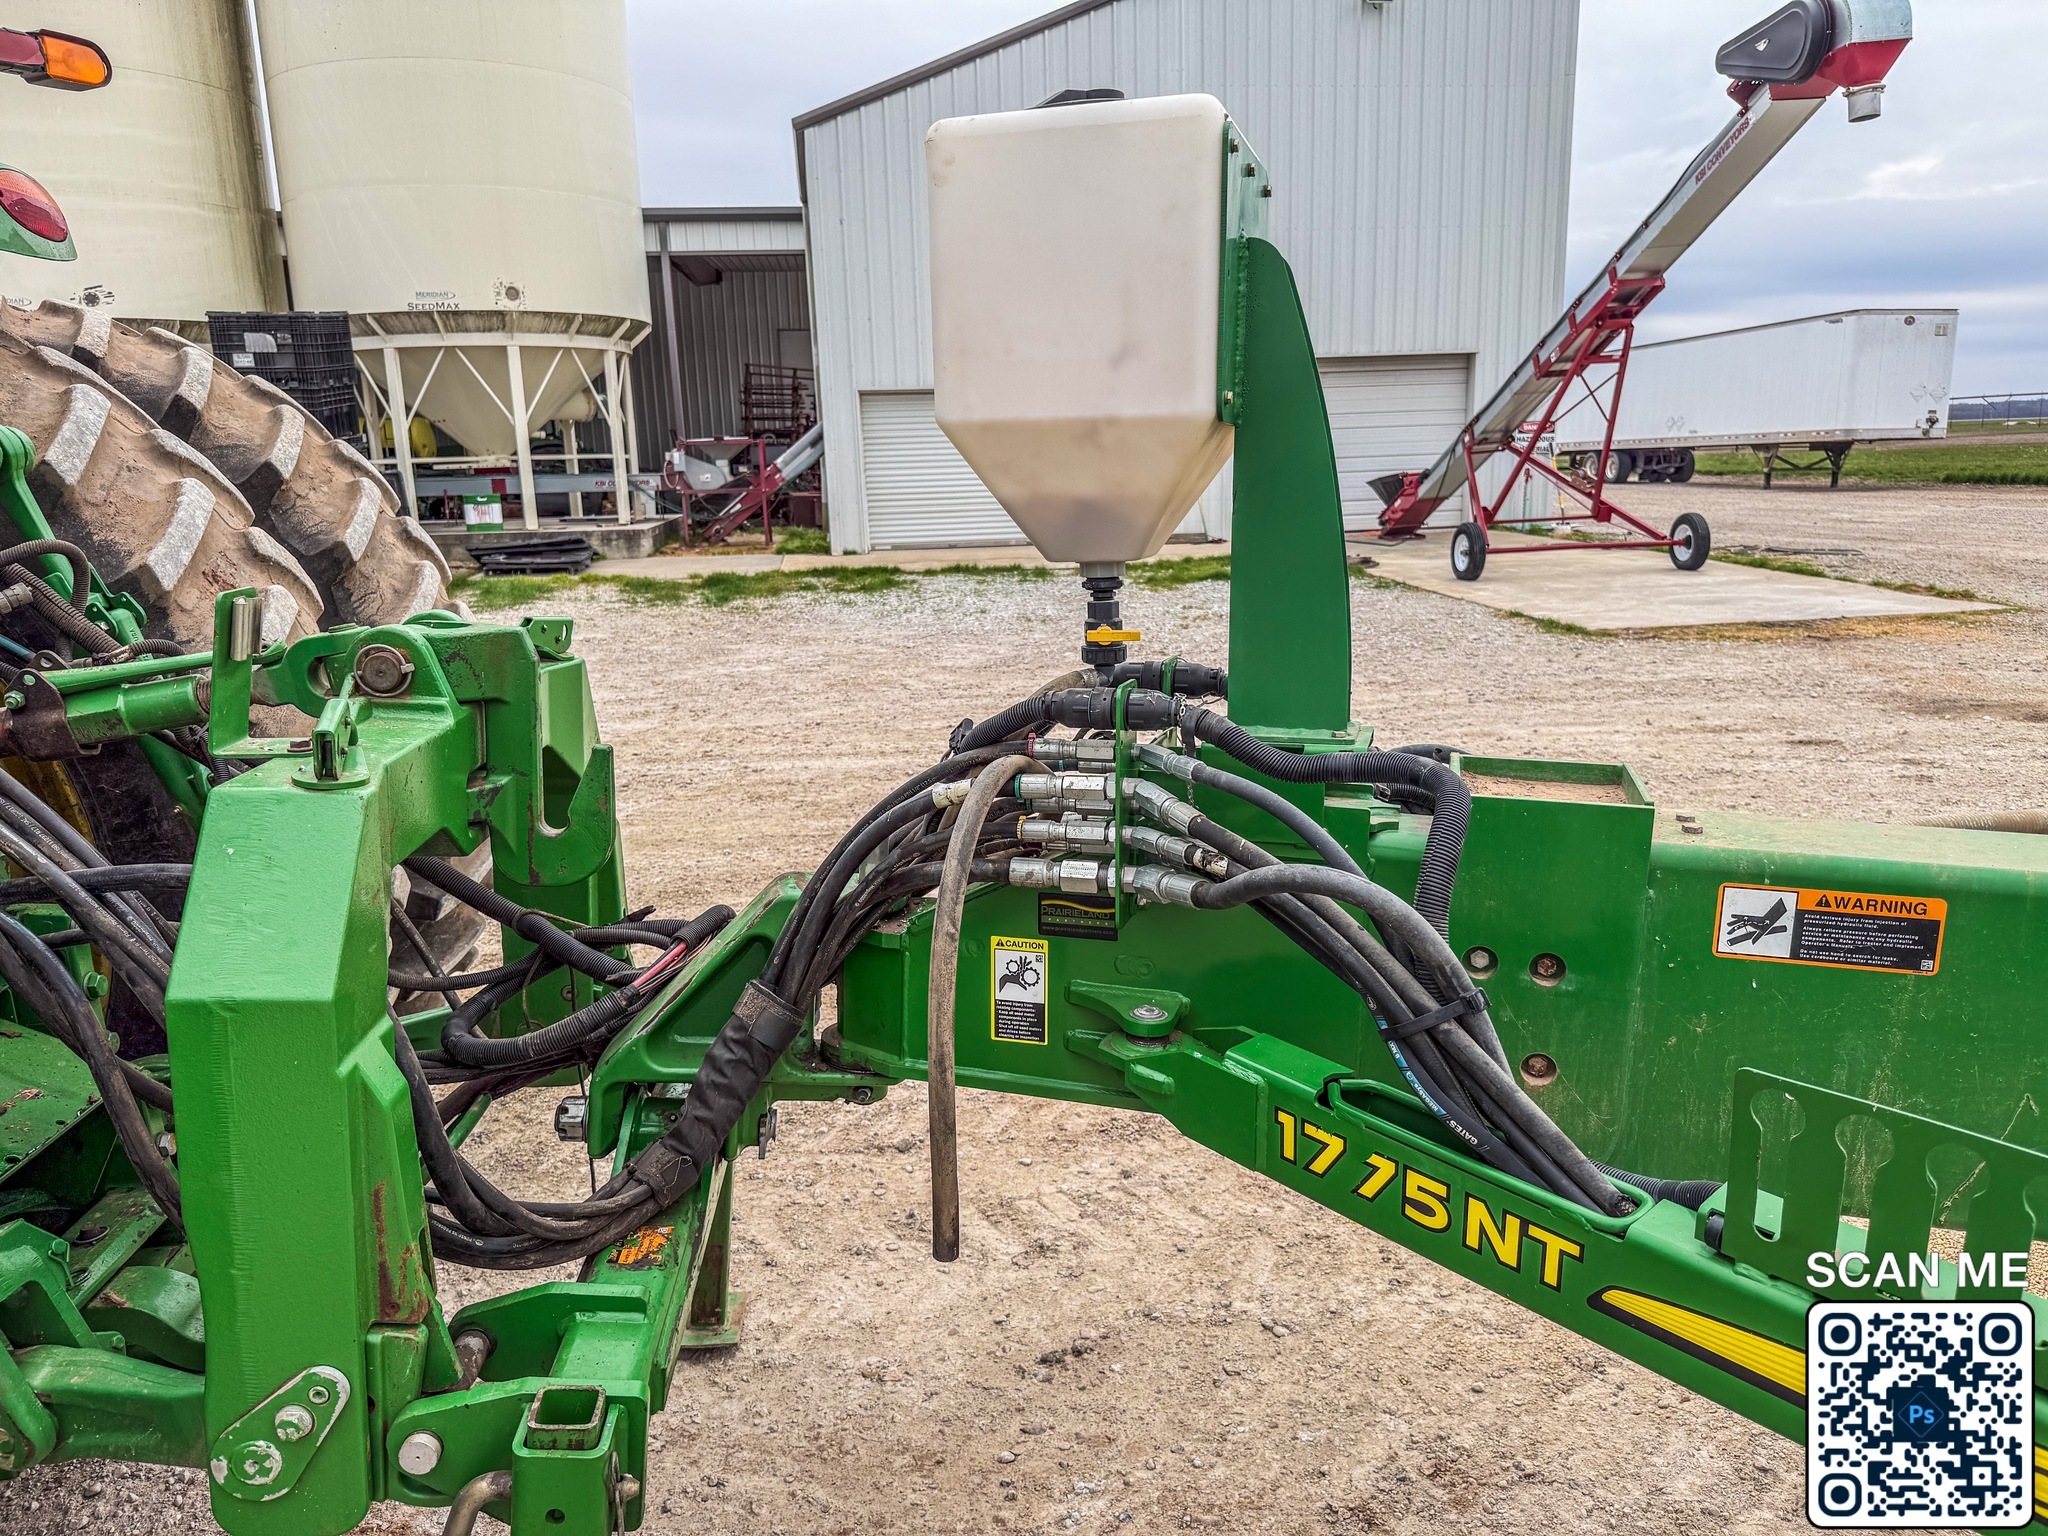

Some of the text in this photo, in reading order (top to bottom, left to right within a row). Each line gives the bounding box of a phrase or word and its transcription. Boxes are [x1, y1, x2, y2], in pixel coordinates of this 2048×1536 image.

[1516, 435, 1555, 443] HAZOUS
[1834, 895, 1927, 916] WARNING
[1005, 940, 1044, 950] CAUTION
[1449, 1119, 1479, 1146] GATES
